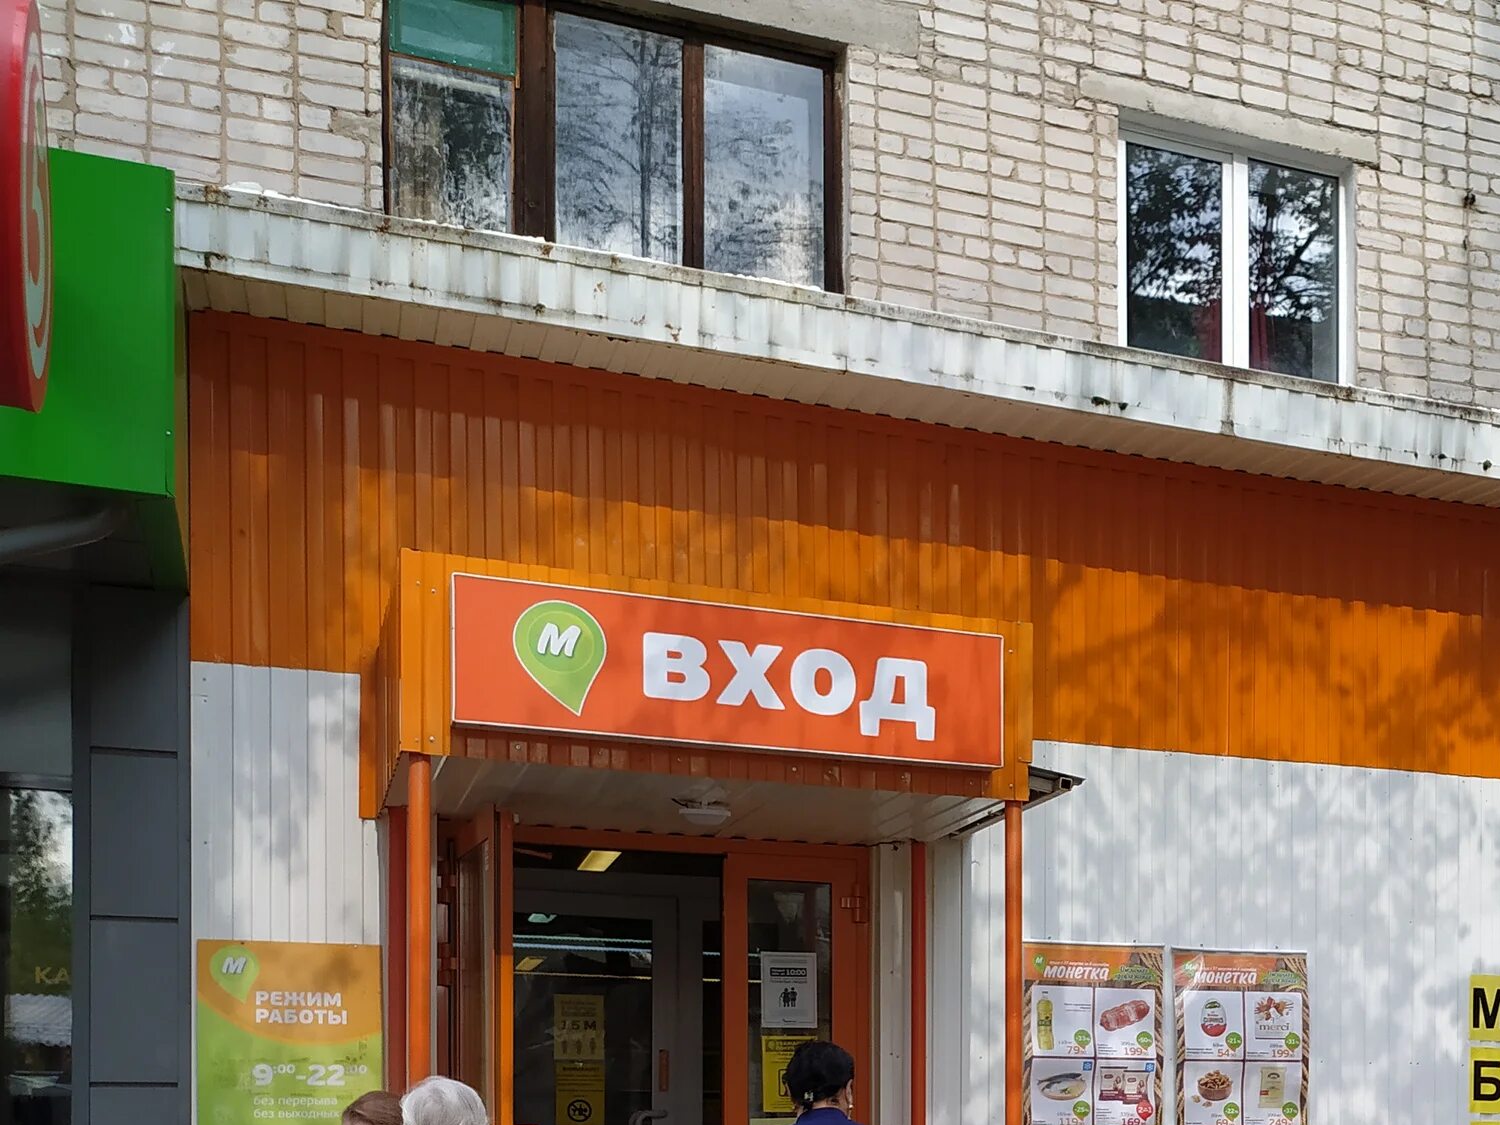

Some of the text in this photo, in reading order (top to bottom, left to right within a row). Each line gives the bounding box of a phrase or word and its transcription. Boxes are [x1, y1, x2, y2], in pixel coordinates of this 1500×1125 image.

[642, 631, 936, 741] ВХОД
[255, 991, 342, 1008] РЕЖИМ
[255, 1008, 348, 1025] РАБОТЫ
[253, 1096, 338, 1108] без перерыва
[253, 1108, 340, 1120] без выходных
